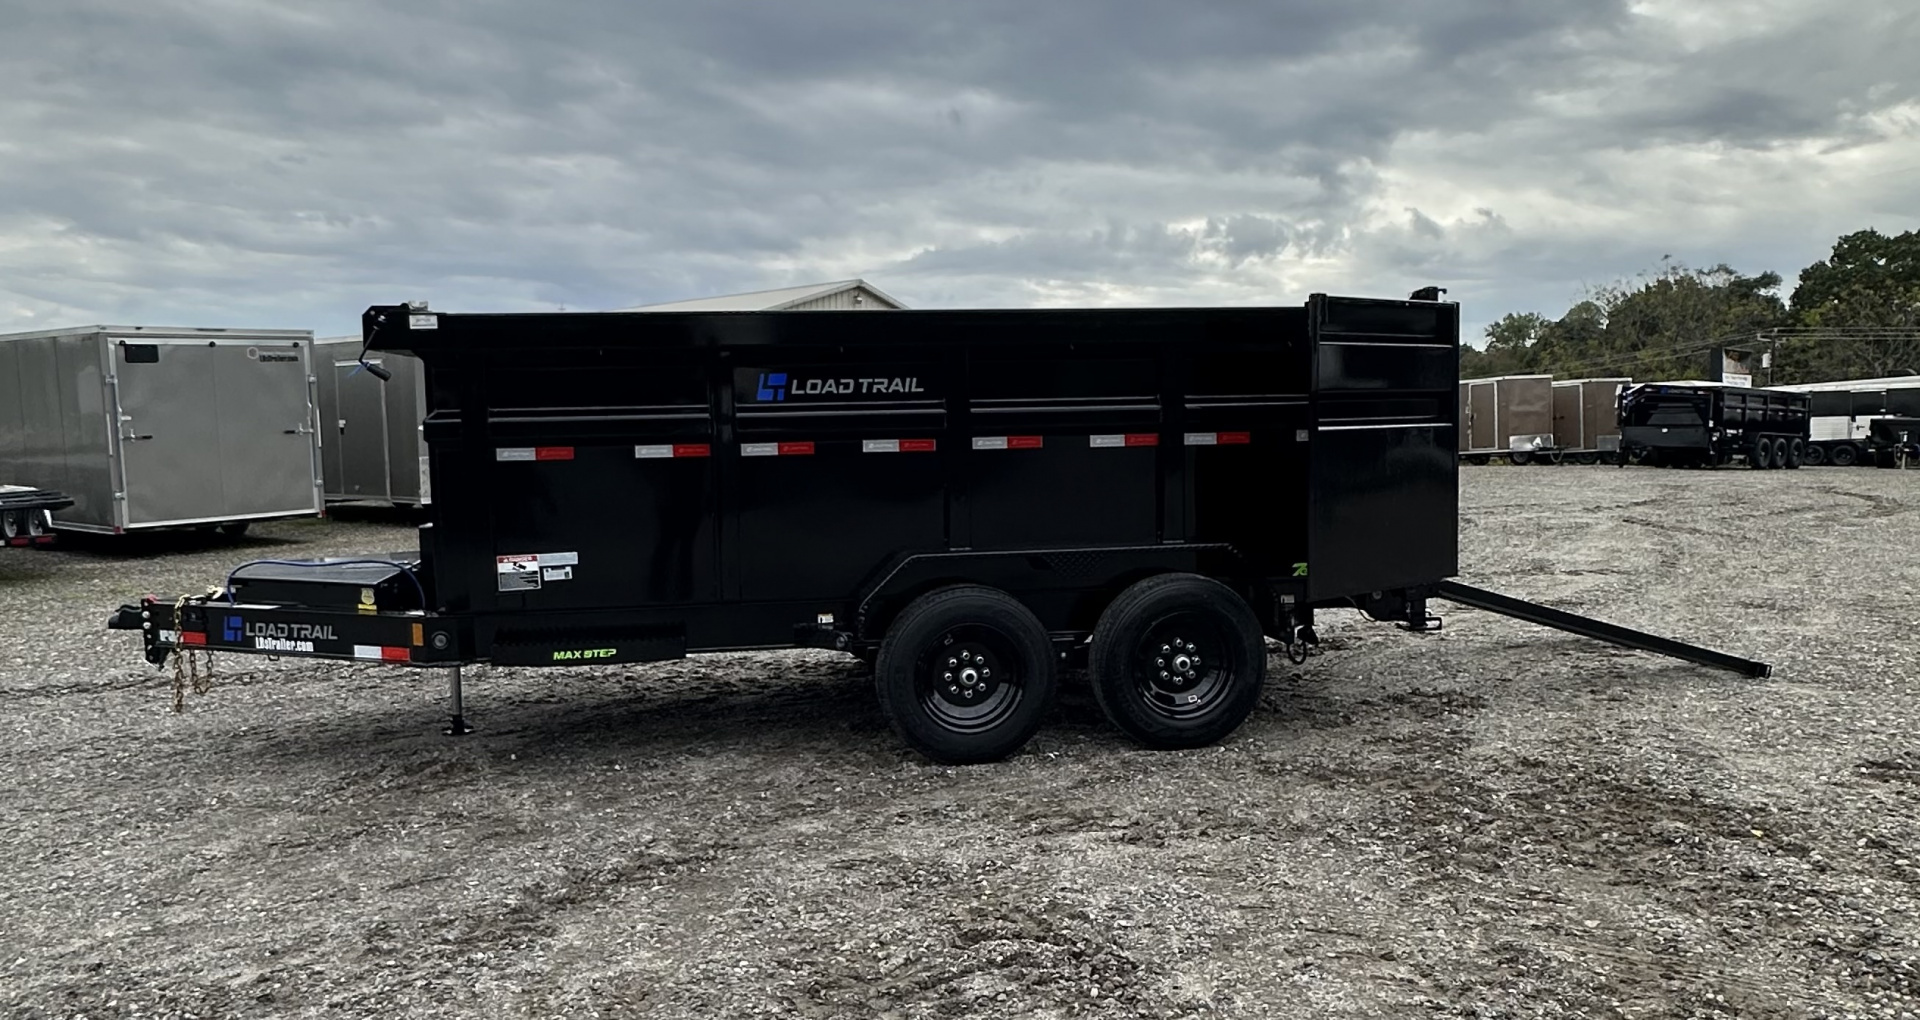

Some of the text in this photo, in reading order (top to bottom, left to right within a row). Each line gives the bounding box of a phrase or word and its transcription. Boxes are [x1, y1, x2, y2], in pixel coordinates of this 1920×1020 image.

[791, 378, 855, 395] LOAD
[858, 377, 925, 394] TRAIL
[245, 622, 289, 638] LOAD
[290, 624, 338, 640] TRAIL
[553, 648, 617, 661] MAX STEP
